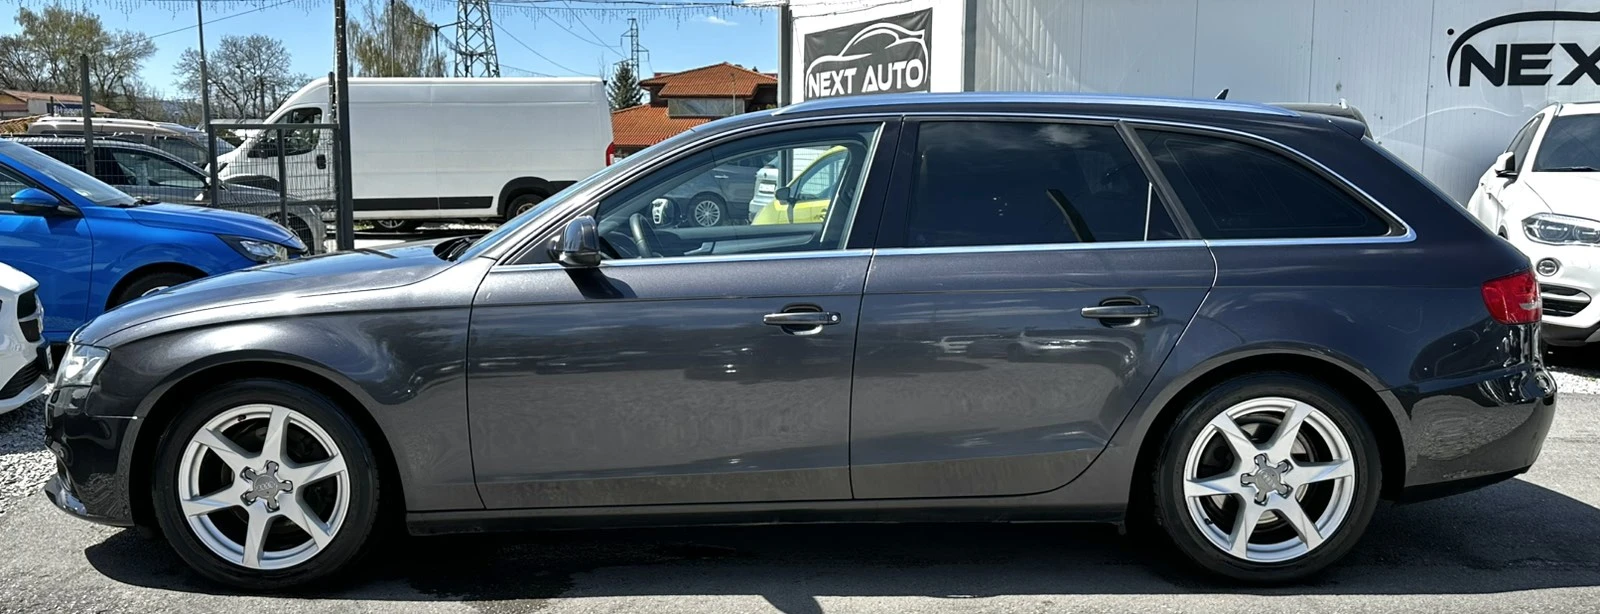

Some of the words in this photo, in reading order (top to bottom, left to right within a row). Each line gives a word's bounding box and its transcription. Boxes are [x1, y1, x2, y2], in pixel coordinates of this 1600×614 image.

[808, 68, 857, 98] NEXT
[861, 58, 924, 93] AUTO
[1458, 43, 1600, 87] NEX
